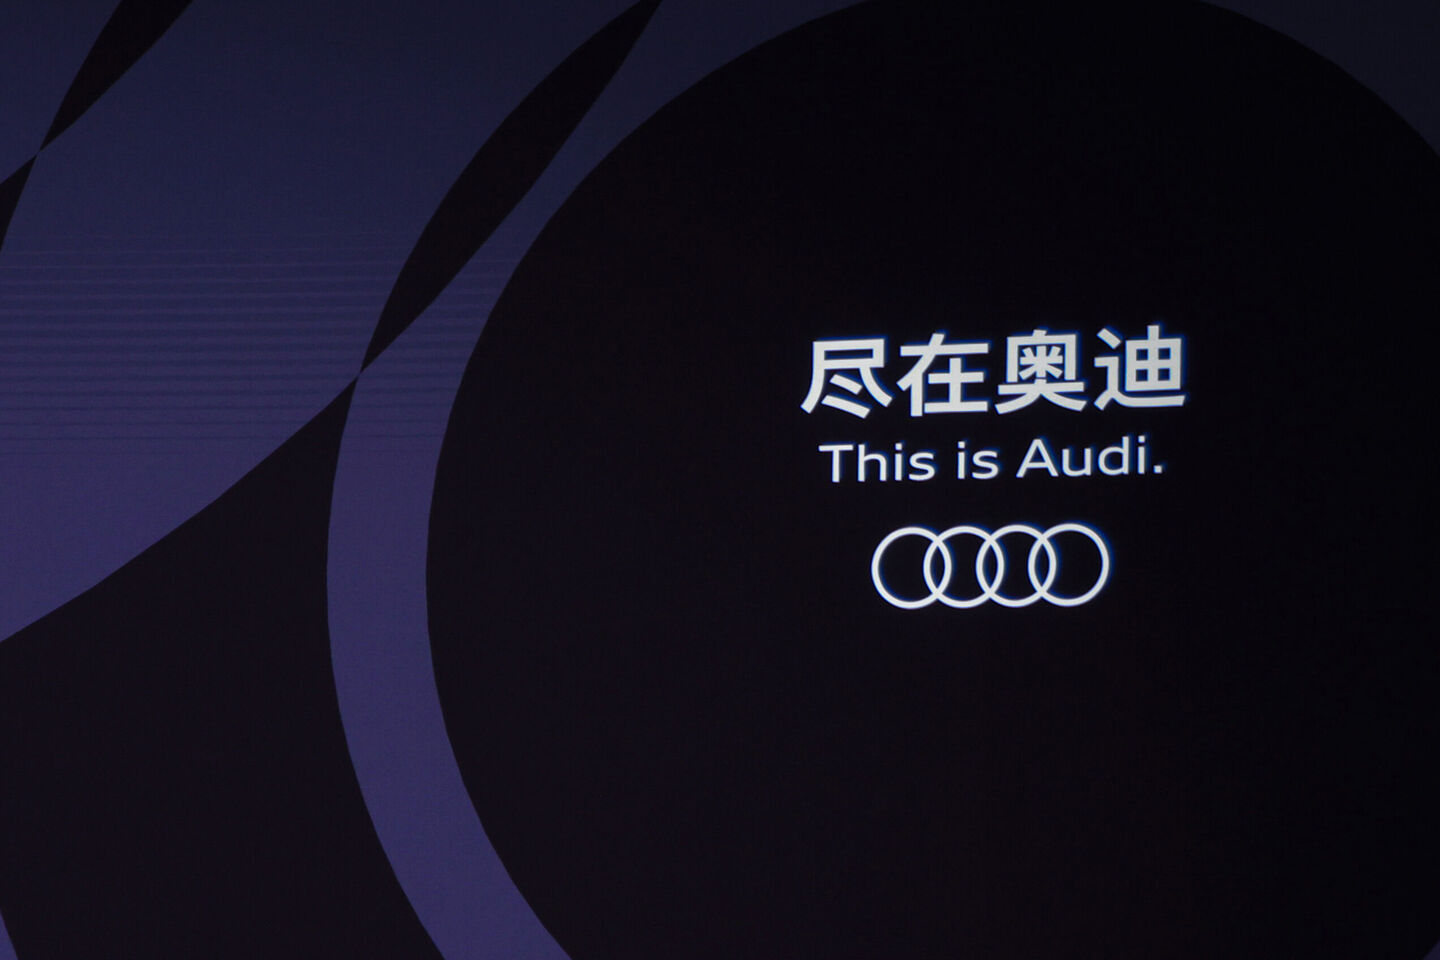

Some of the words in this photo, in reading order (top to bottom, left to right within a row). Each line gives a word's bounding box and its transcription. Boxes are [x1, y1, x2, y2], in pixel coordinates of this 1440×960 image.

[800, 325, 1186, 418] 尽在奥迪
[818, 442, 936, 483] This
[957, 441, 1000, 480] is
[1016, 434, 1164, 478] Audi.
